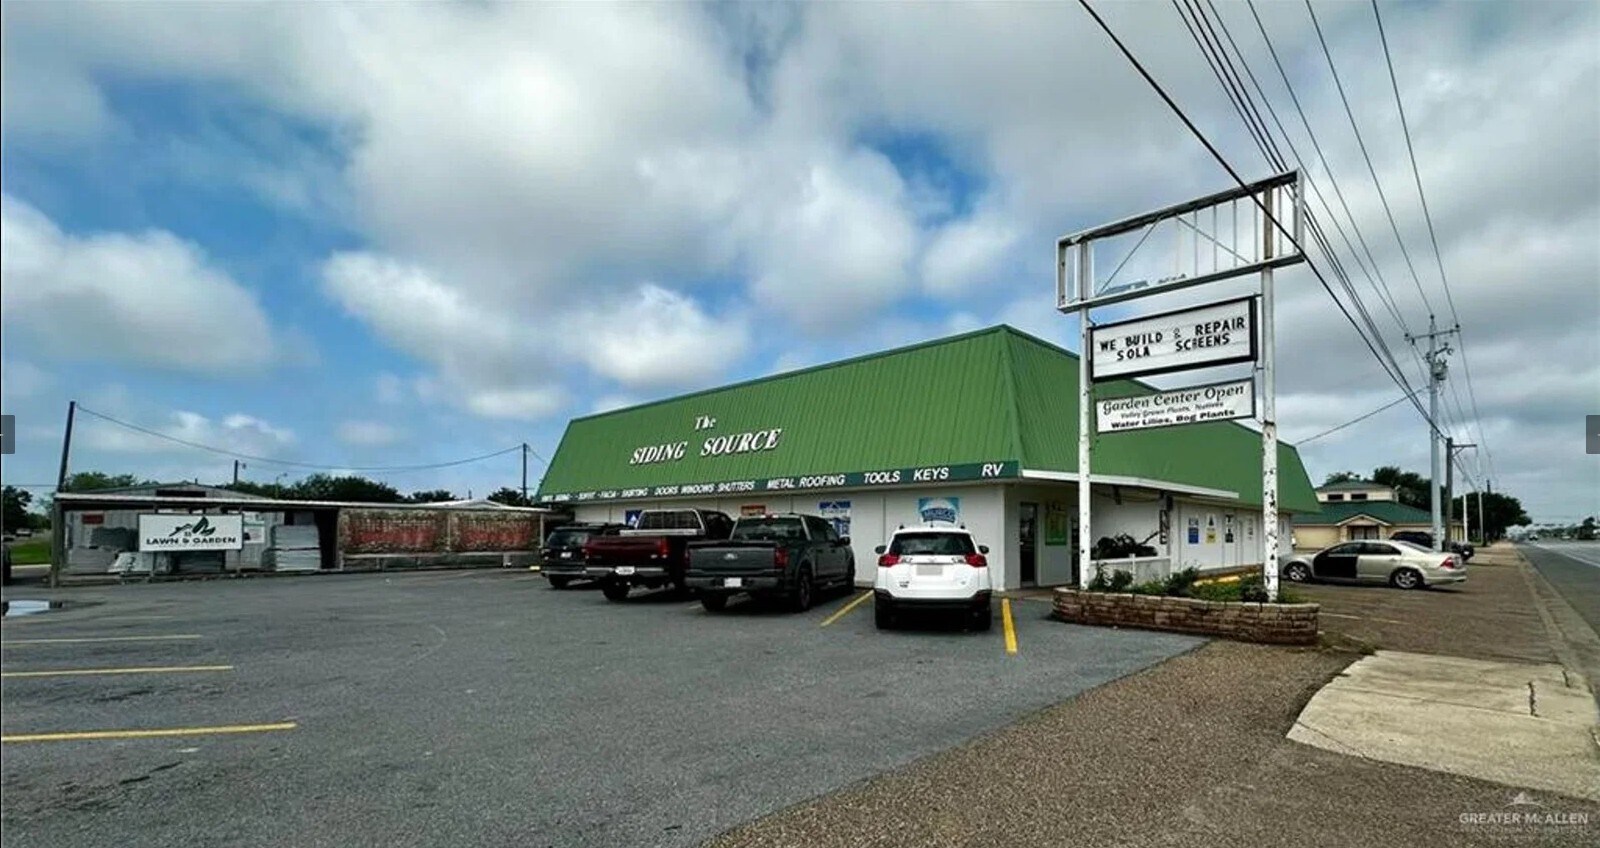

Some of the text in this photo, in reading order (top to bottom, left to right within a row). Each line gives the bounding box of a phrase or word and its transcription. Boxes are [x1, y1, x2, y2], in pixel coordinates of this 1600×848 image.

[1100, 339, 1116, 352] WE
[1125, 332, 1163, 347] BUILD
[1195, 317, 1245, 336] REPAIR
[1116, 333, 1230, 361] SOLA SCREENS
[1103, 385, 1244, 416] Garden Center Open
[695, 415, 716, 430] The
[1111, 419, 1139, 429] Water
[1176, 414, 1196, 423] Bog
[1200, 408, 1235, 420] Plants
[629, 428, 782, 464] SIDING SOURCE
[654, 485, 678, 496] DOORS
[680, 483, 714, 495] WINDOWS
[717, 480, 755, 493] SHUTTERS
[766, 477, 795, 490] METAL
[799, 474, 846, 488] ROOFING
[863, 470, 901, 484] TOOLS
[913, 467, 949, 481] KEYS
[981, 463, 1003, 477] RV
[146, 537, 179, 545] LAWN
[192, 536, 236, 544] GARDEN
